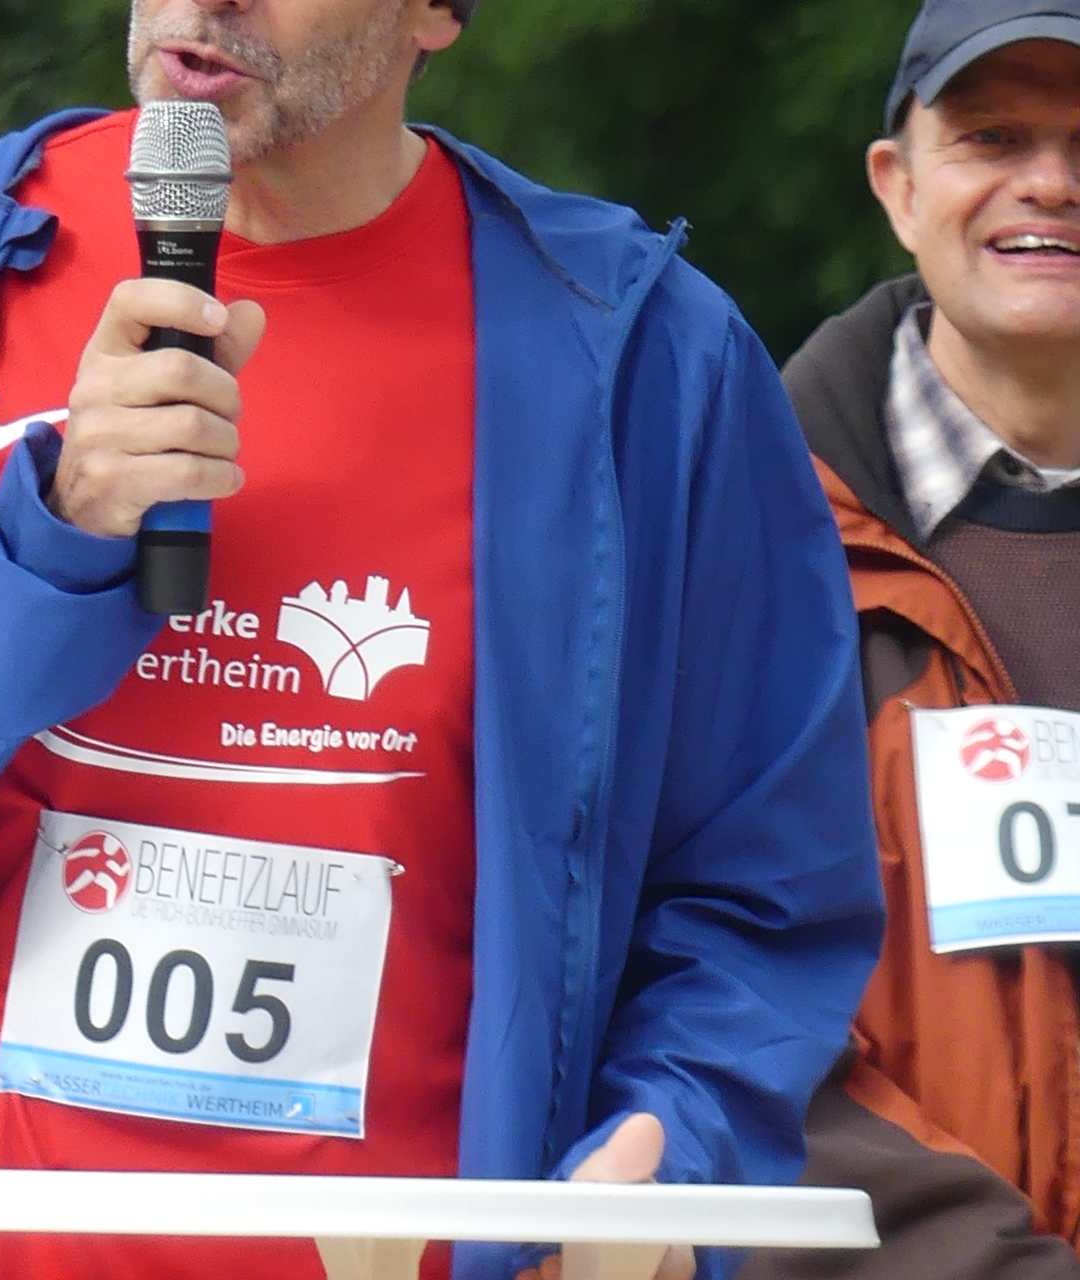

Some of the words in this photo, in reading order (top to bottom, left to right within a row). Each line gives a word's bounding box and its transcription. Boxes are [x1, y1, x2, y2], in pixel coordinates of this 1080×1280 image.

[169, 600, 260, 639] erke
[136, 648, 301, 694] ertheim
[221, 722, 257, 747] Die
[261, 722, 343, 752] Energie
[346, 730, 380, 750] vor
[381, 728, 418, 752] Ort
[134, 840, 345, 917] BENEFIZLAUF
[72, 937, 297, 1064] 005
[186, 1093, 285, 1117] WERTHEIM
